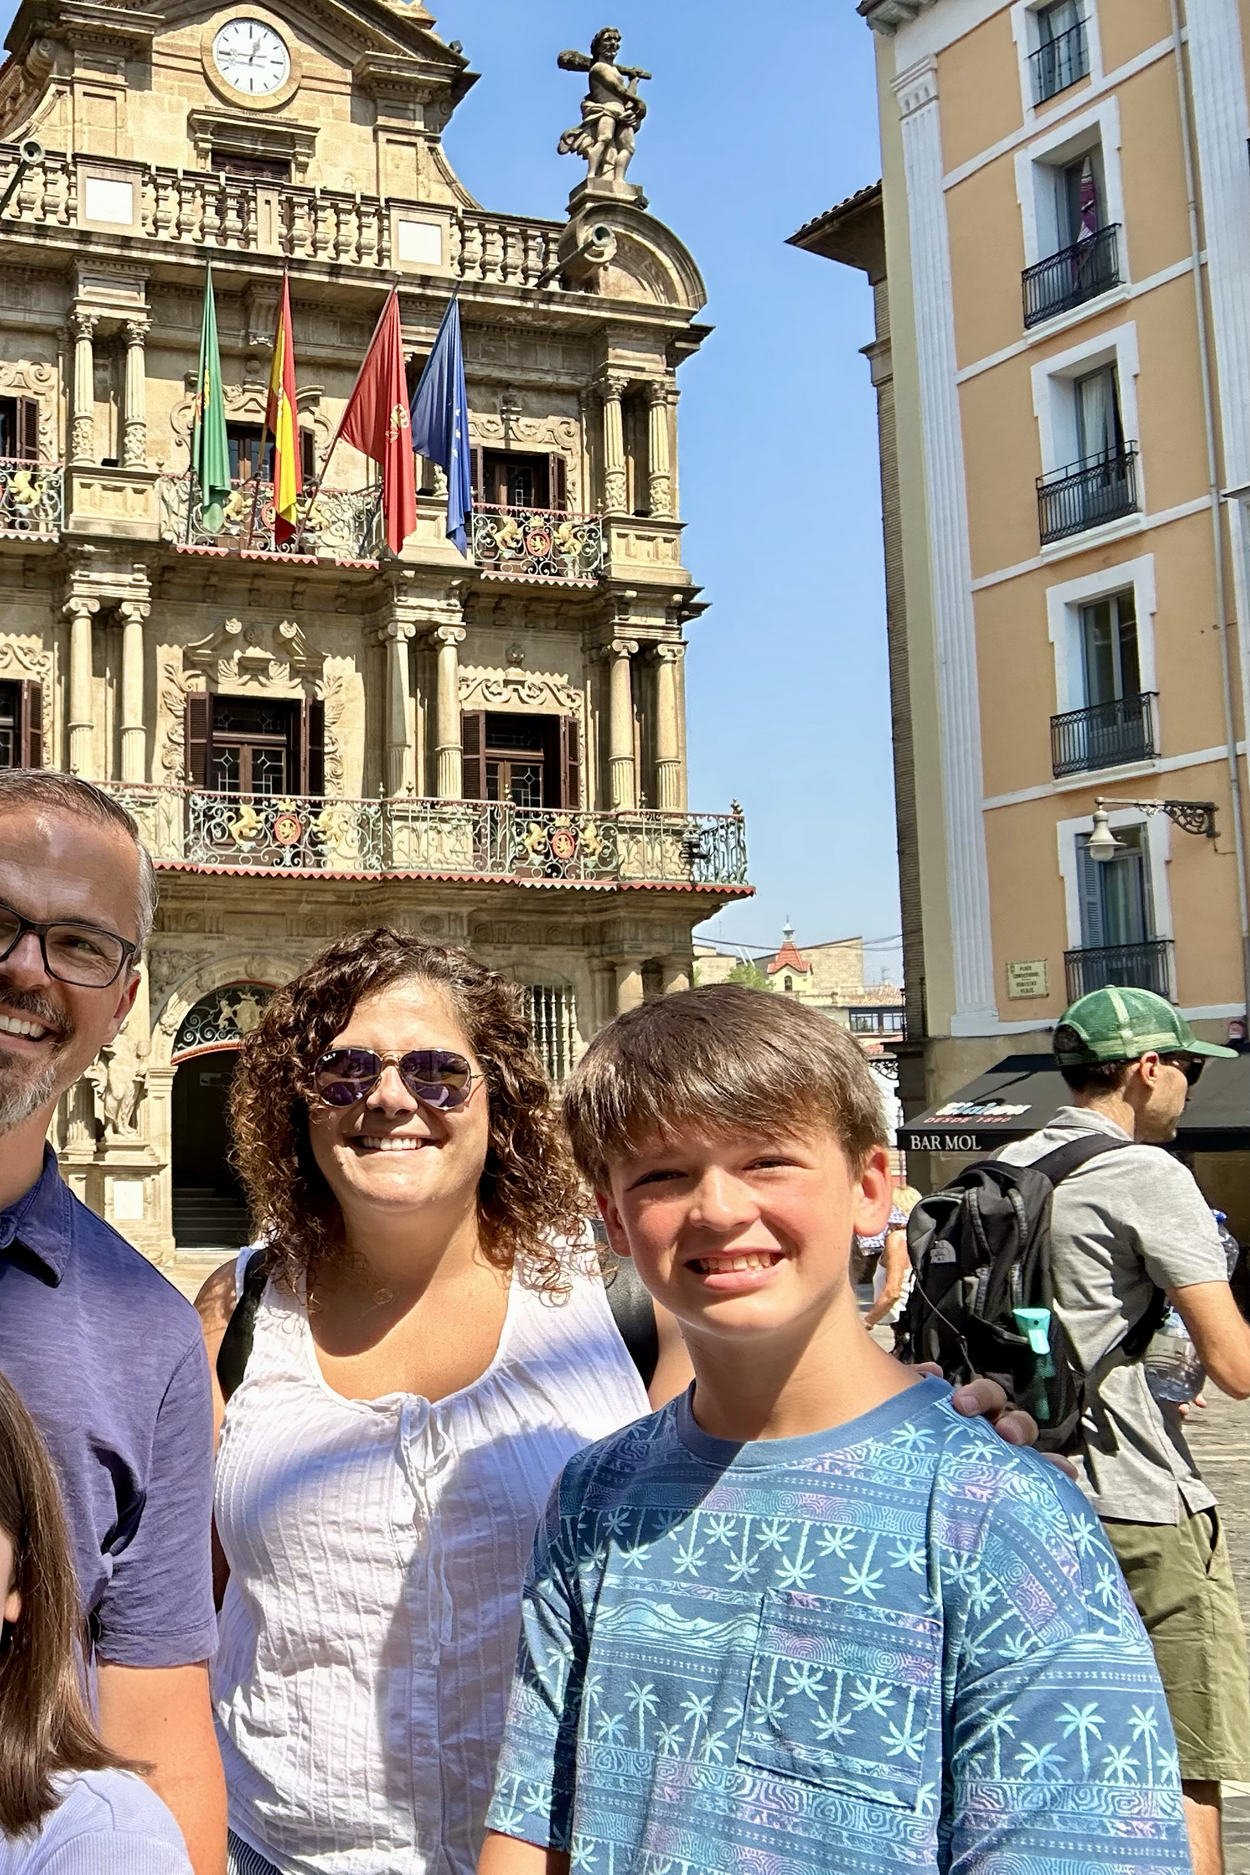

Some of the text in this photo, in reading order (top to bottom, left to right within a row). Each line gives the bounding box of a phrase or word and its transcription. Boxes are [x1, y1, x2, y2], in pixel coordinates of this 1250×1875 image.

[923, 1116, 972, 1124] DESDE
[910, 1135, 982, 1150] BAR MOL
